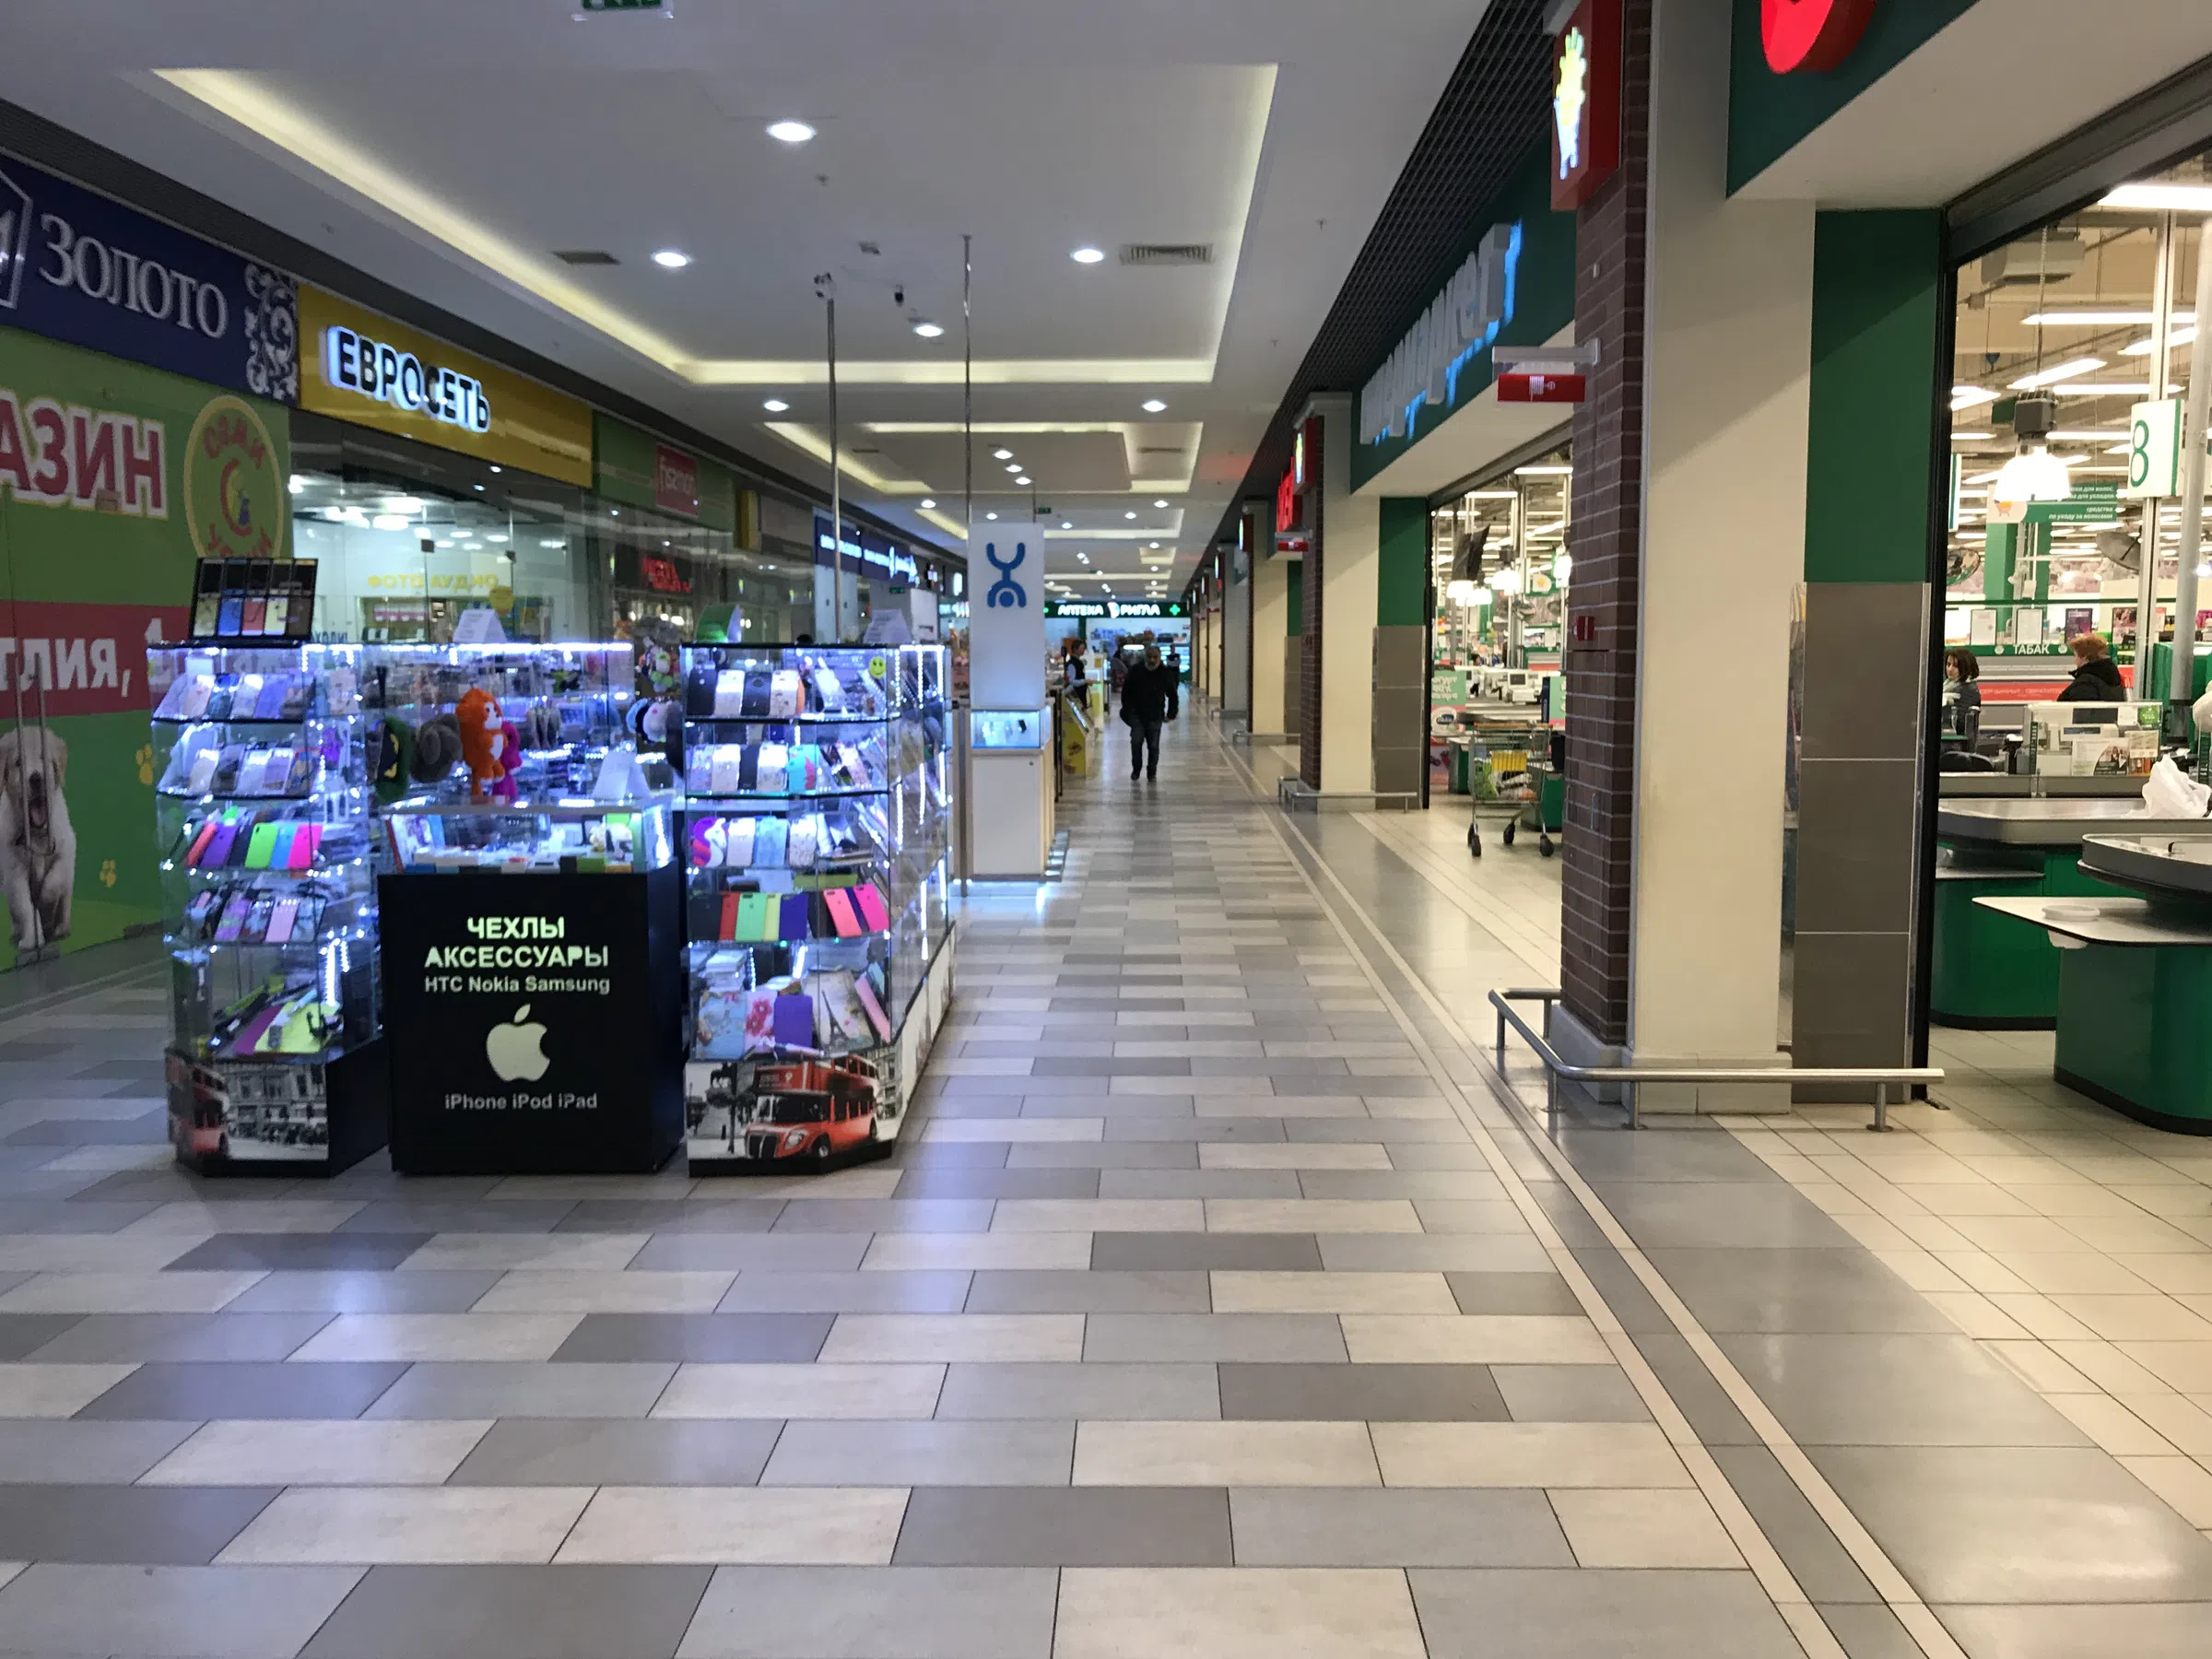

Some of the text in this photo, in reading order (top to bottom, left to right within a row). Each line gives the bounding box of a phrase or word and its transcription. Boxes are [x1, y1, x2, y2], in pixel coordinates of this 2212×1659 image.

[327, 325, 491, 433] ЕВРОСЕТЬ
[2130, 419, 2149, 488] 8
[367, 573, 499, 591] ФОТО АУДИО
[1057, 604, 1160, 616] АПТЕКА РИГЛА
[2013, 643, 2050, 655] ТАБАК
[467, 915, 565, 939] ЧЕХЛЫ
[424, 945, 609, 968] АКСЕССУАРЫ
[424, 974, 611, 995] HTC Nokia Samsung
[444, 1093, 598, 1110] iPhone iPod iPad
